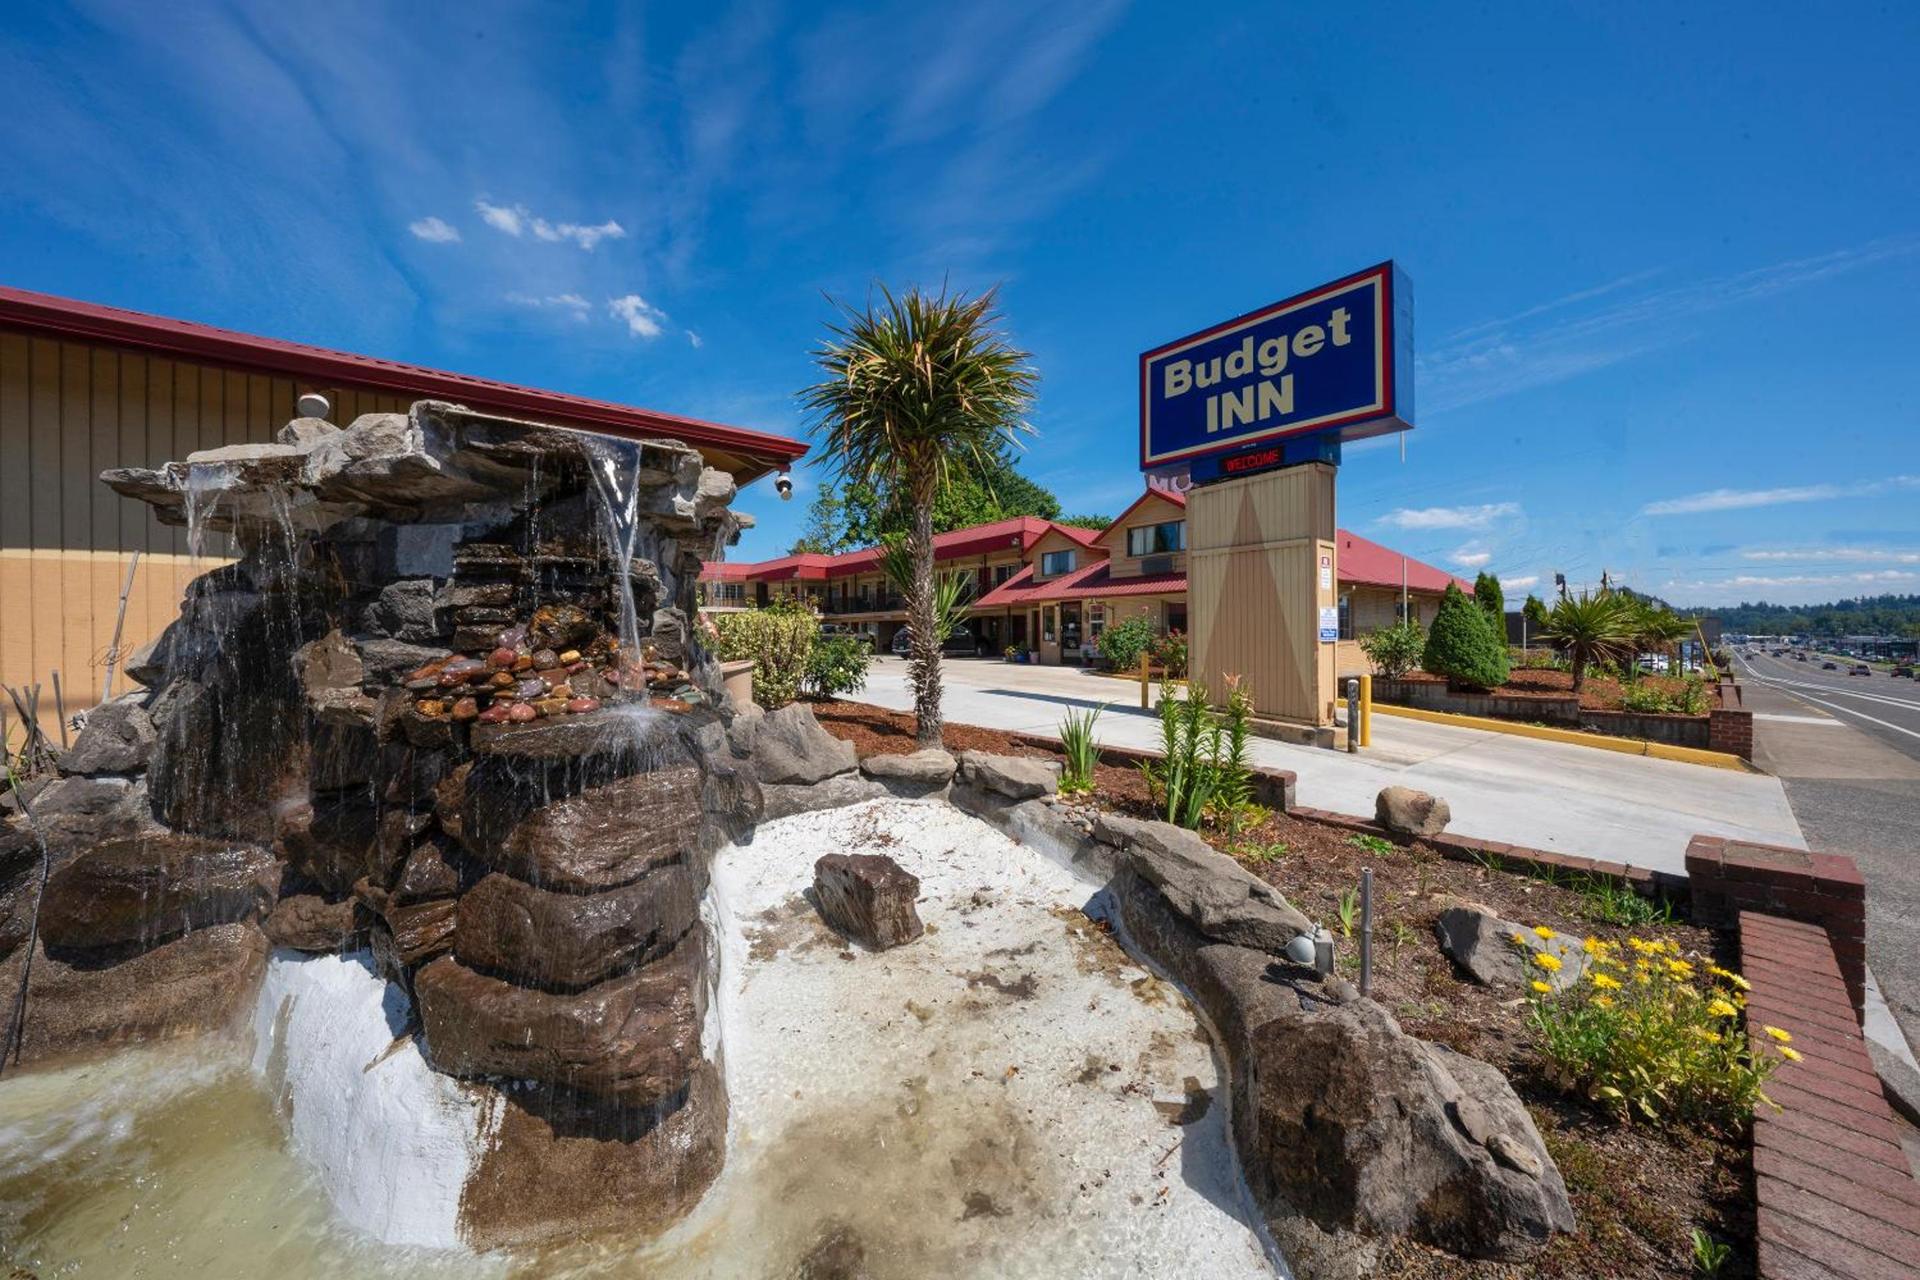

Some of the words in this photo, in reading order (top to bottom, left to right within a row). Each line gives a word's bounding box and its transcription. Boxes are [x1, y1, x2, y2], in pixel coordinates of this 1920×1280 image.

[1164, 306, 1351, 399] Budget
[1206, 374, 1294, 433] INN
[1226, 449, 1279, 472] WELCOME
